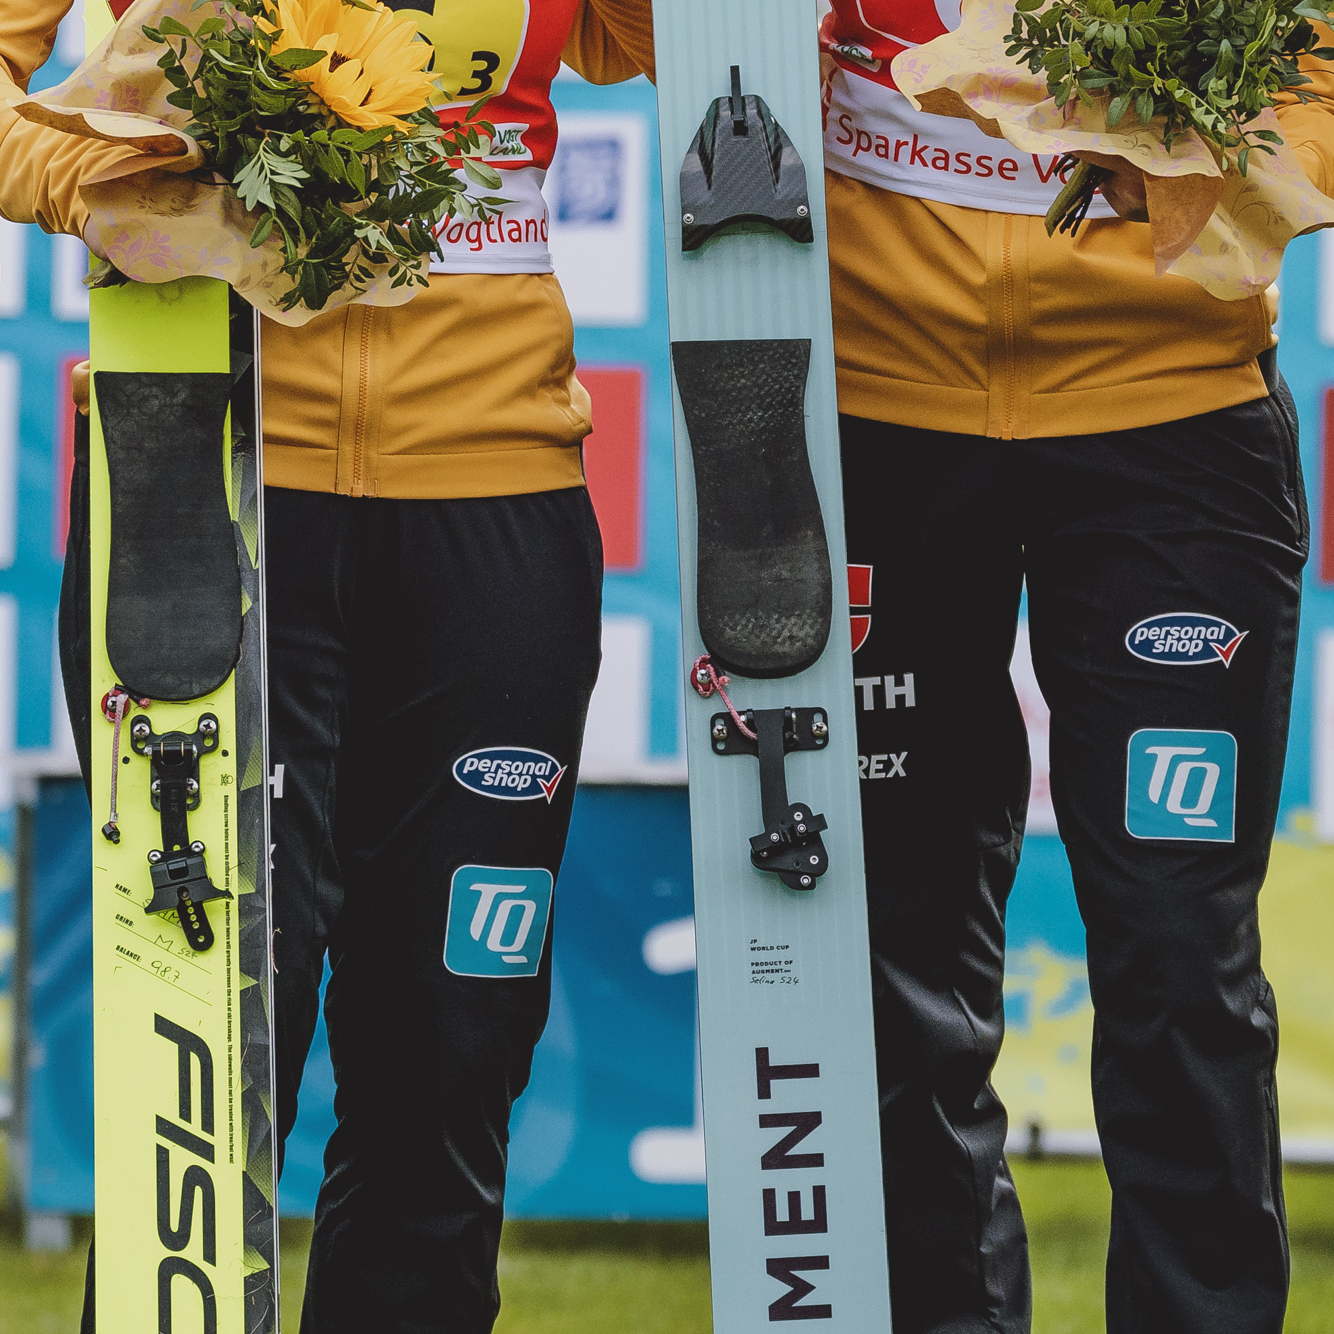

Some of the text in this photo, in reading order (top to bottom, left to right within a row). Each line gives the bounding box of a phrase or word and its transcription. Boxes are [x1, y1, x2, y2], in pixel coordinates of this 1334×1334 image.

[456, 50, 501, 97] 3
[836, 113, 1019, 181] Sparkasse
[431, 209, 549, 252] Vogtland
[1134, 623, 1228, 650] personal
[1152, 637, 1205, 658] shop
[463, 754, 553, 782] personal
[482, 769, 532, 792] shop
[1144, 745, 1221, 828] TQ
[114, 882, 133, 897] NAME:
[114, 913, 135, 929] GRIND:
[469, 882, 535, 964] TQ
[115, 944, 143, 963] BALANCE:
[153, 933, 174, 952] M
